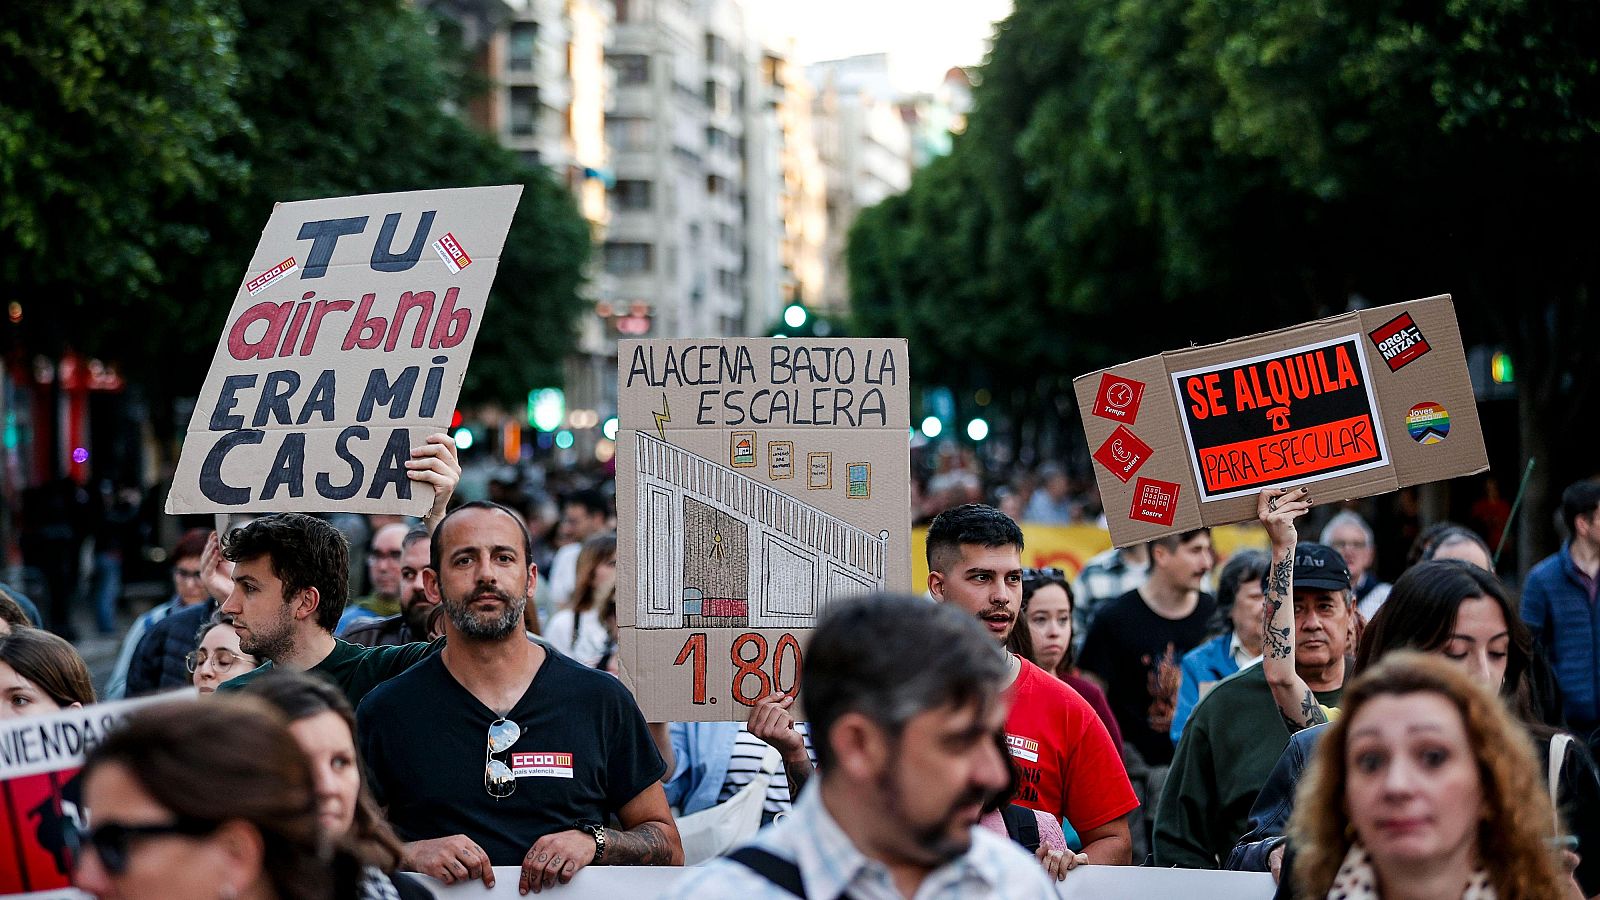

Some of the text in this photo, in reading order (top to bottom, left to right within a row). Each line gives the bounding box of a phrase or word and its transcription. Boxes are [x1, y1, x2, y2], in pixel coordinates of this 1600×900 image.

[296, 211, 437, 279] TU
[248, 266, 281, 290] CCOO
[227, 287, 472, 361] airbnb
[627, 345, 896, 388] ALACENA BAJO LA
[1186, 345, 1359, 420] SE ALQUILA
[209, 369, 336, 431] ERA
[697, 387, 886, 427] ESCALERA
[1104, 405, 1126, 417] Temps
[1409, 408, 1434, 417] Joves
[199, 425, 413, 505] CASA
[1123, 453, 1141, 473] Salari
[1205, 420, 1373, 486] PARA ESPECULAR
[1141, 509, 1163, 519] Sostre
[513, 755, 555, 766] CCOO
